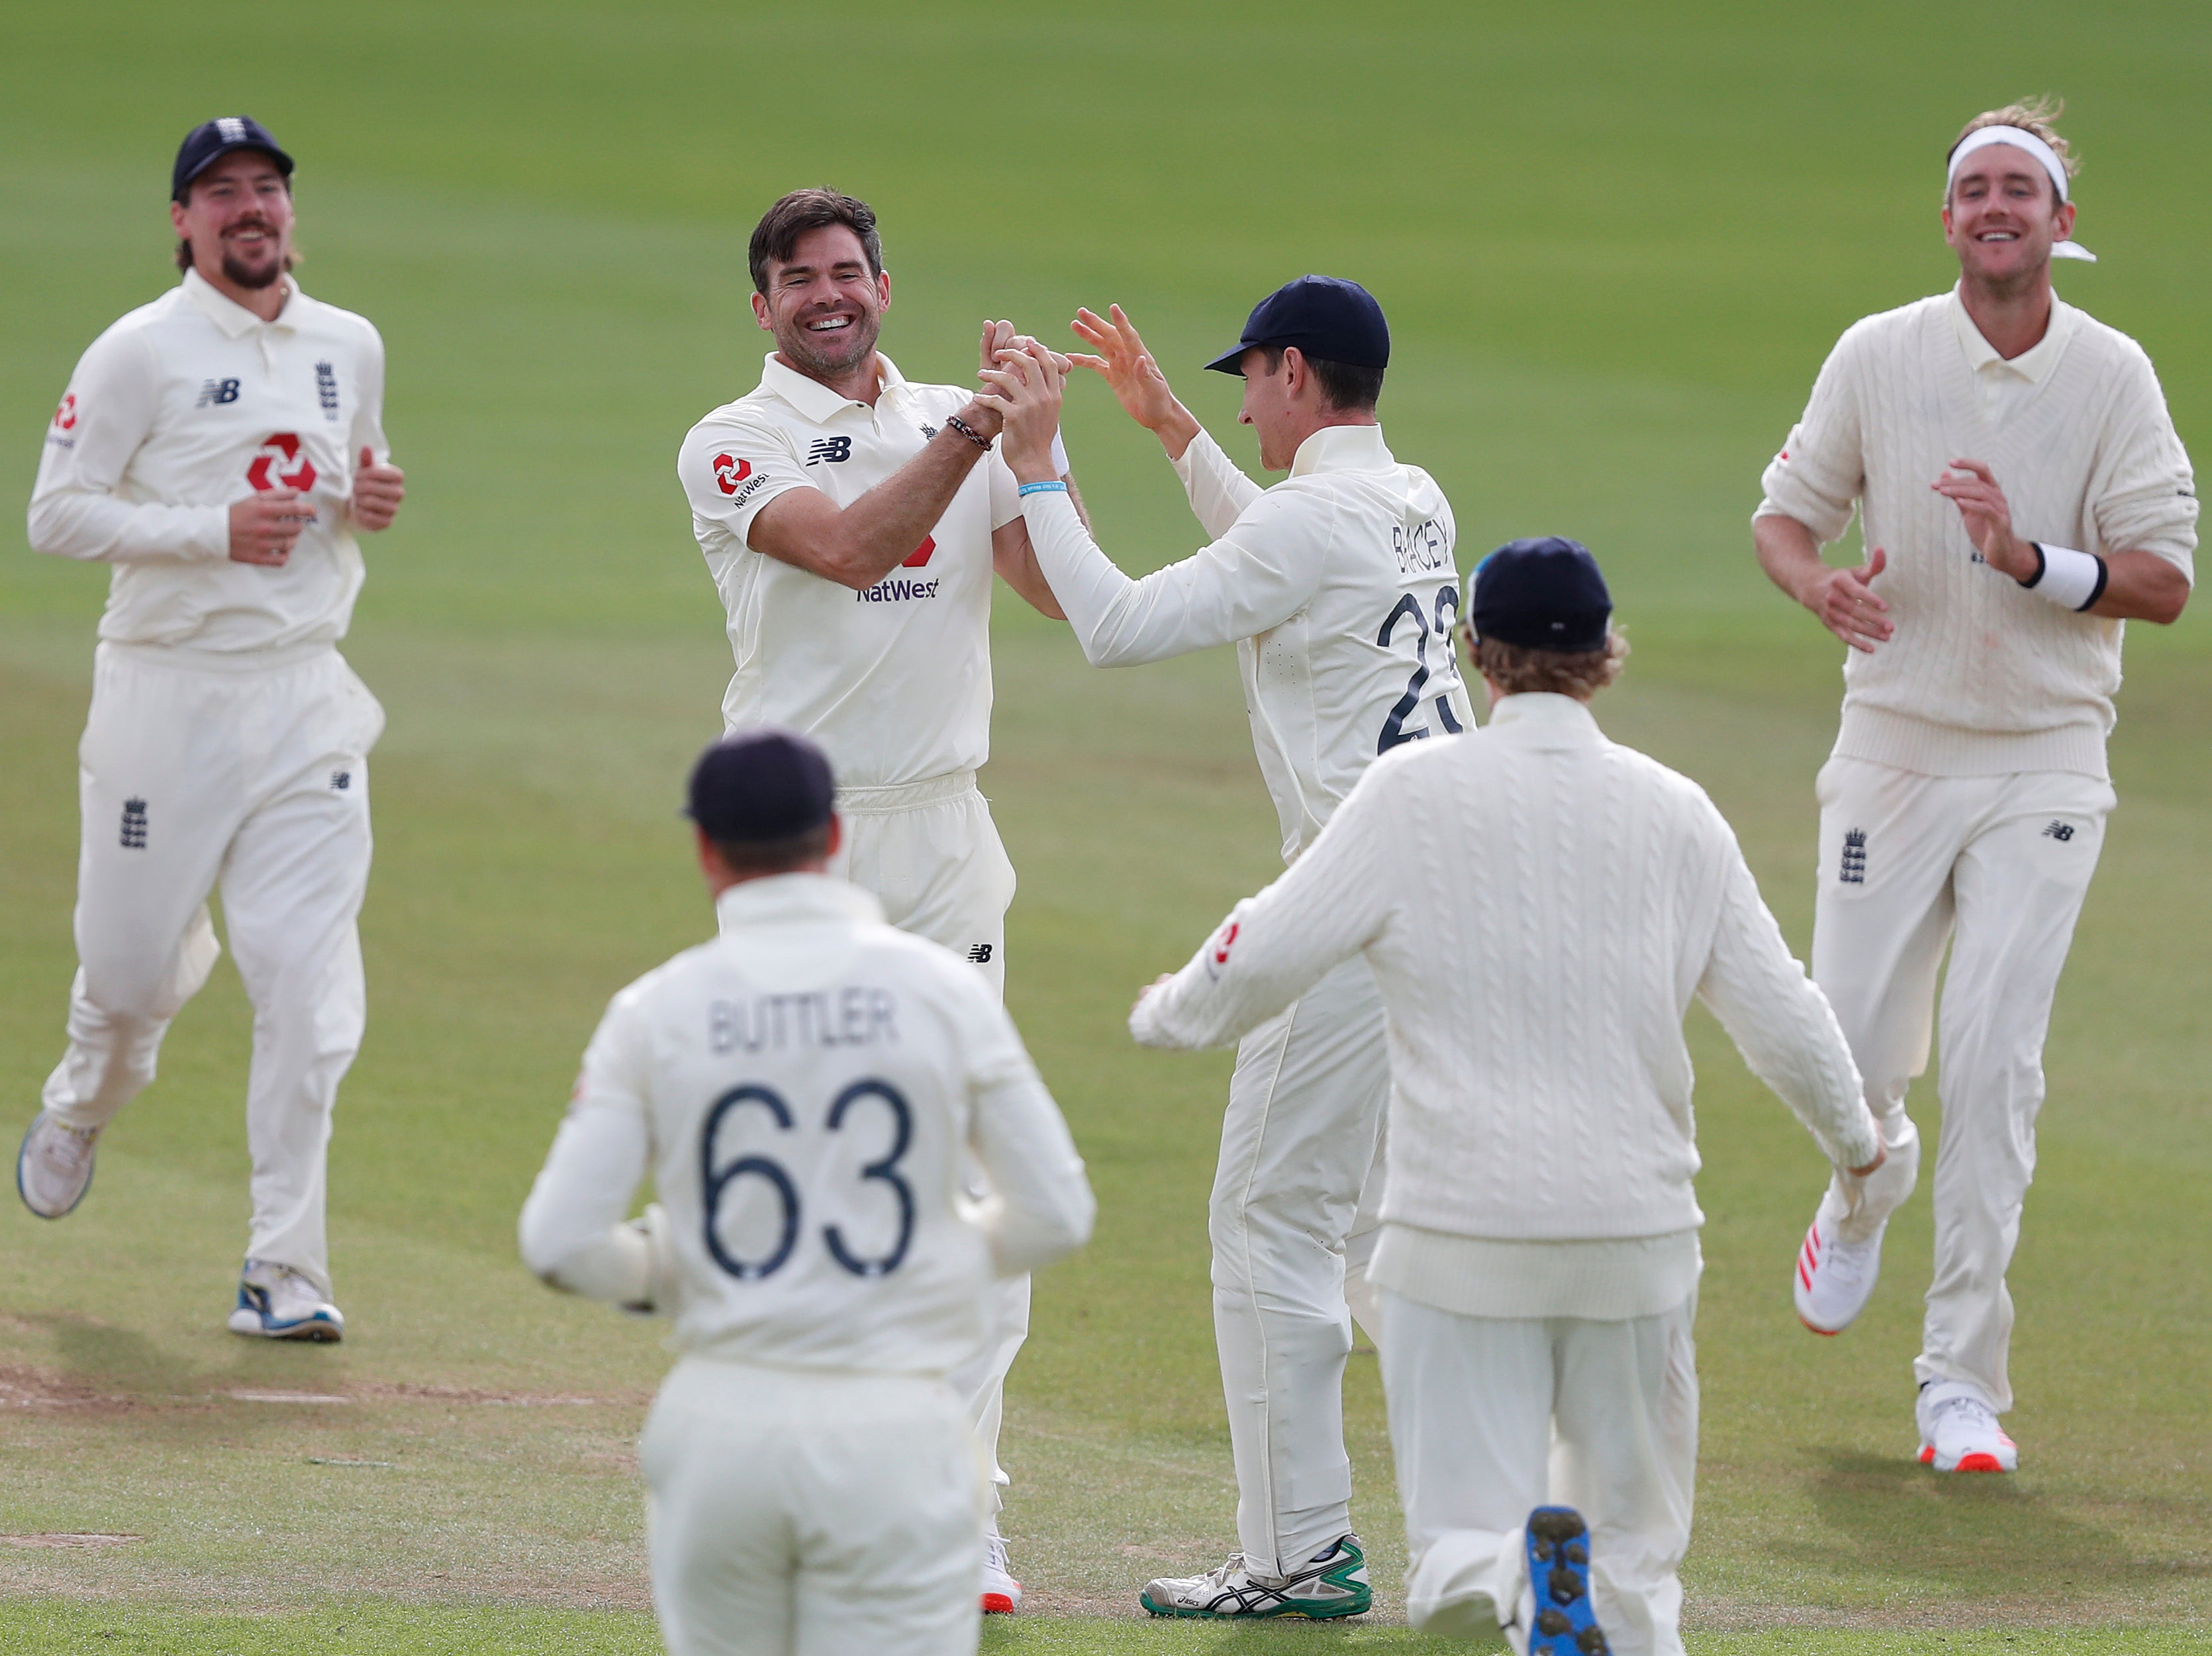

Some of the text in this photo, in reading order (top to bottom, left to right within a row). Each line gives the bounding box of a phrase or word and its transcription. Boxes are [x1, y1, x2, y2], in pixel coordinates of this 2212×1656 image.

[734, 473, 770, 509] NatWest
[1392, 516, 1448, 573] BACEY
[857, 578, 939, 602] NatWest
[1377, 585, 1463, 756] 23
[708, 987, 900, 1055] BUTTLER
[698, 1077, 917, 1281] 63
[1184, 1598, 1200, 1606] asics
